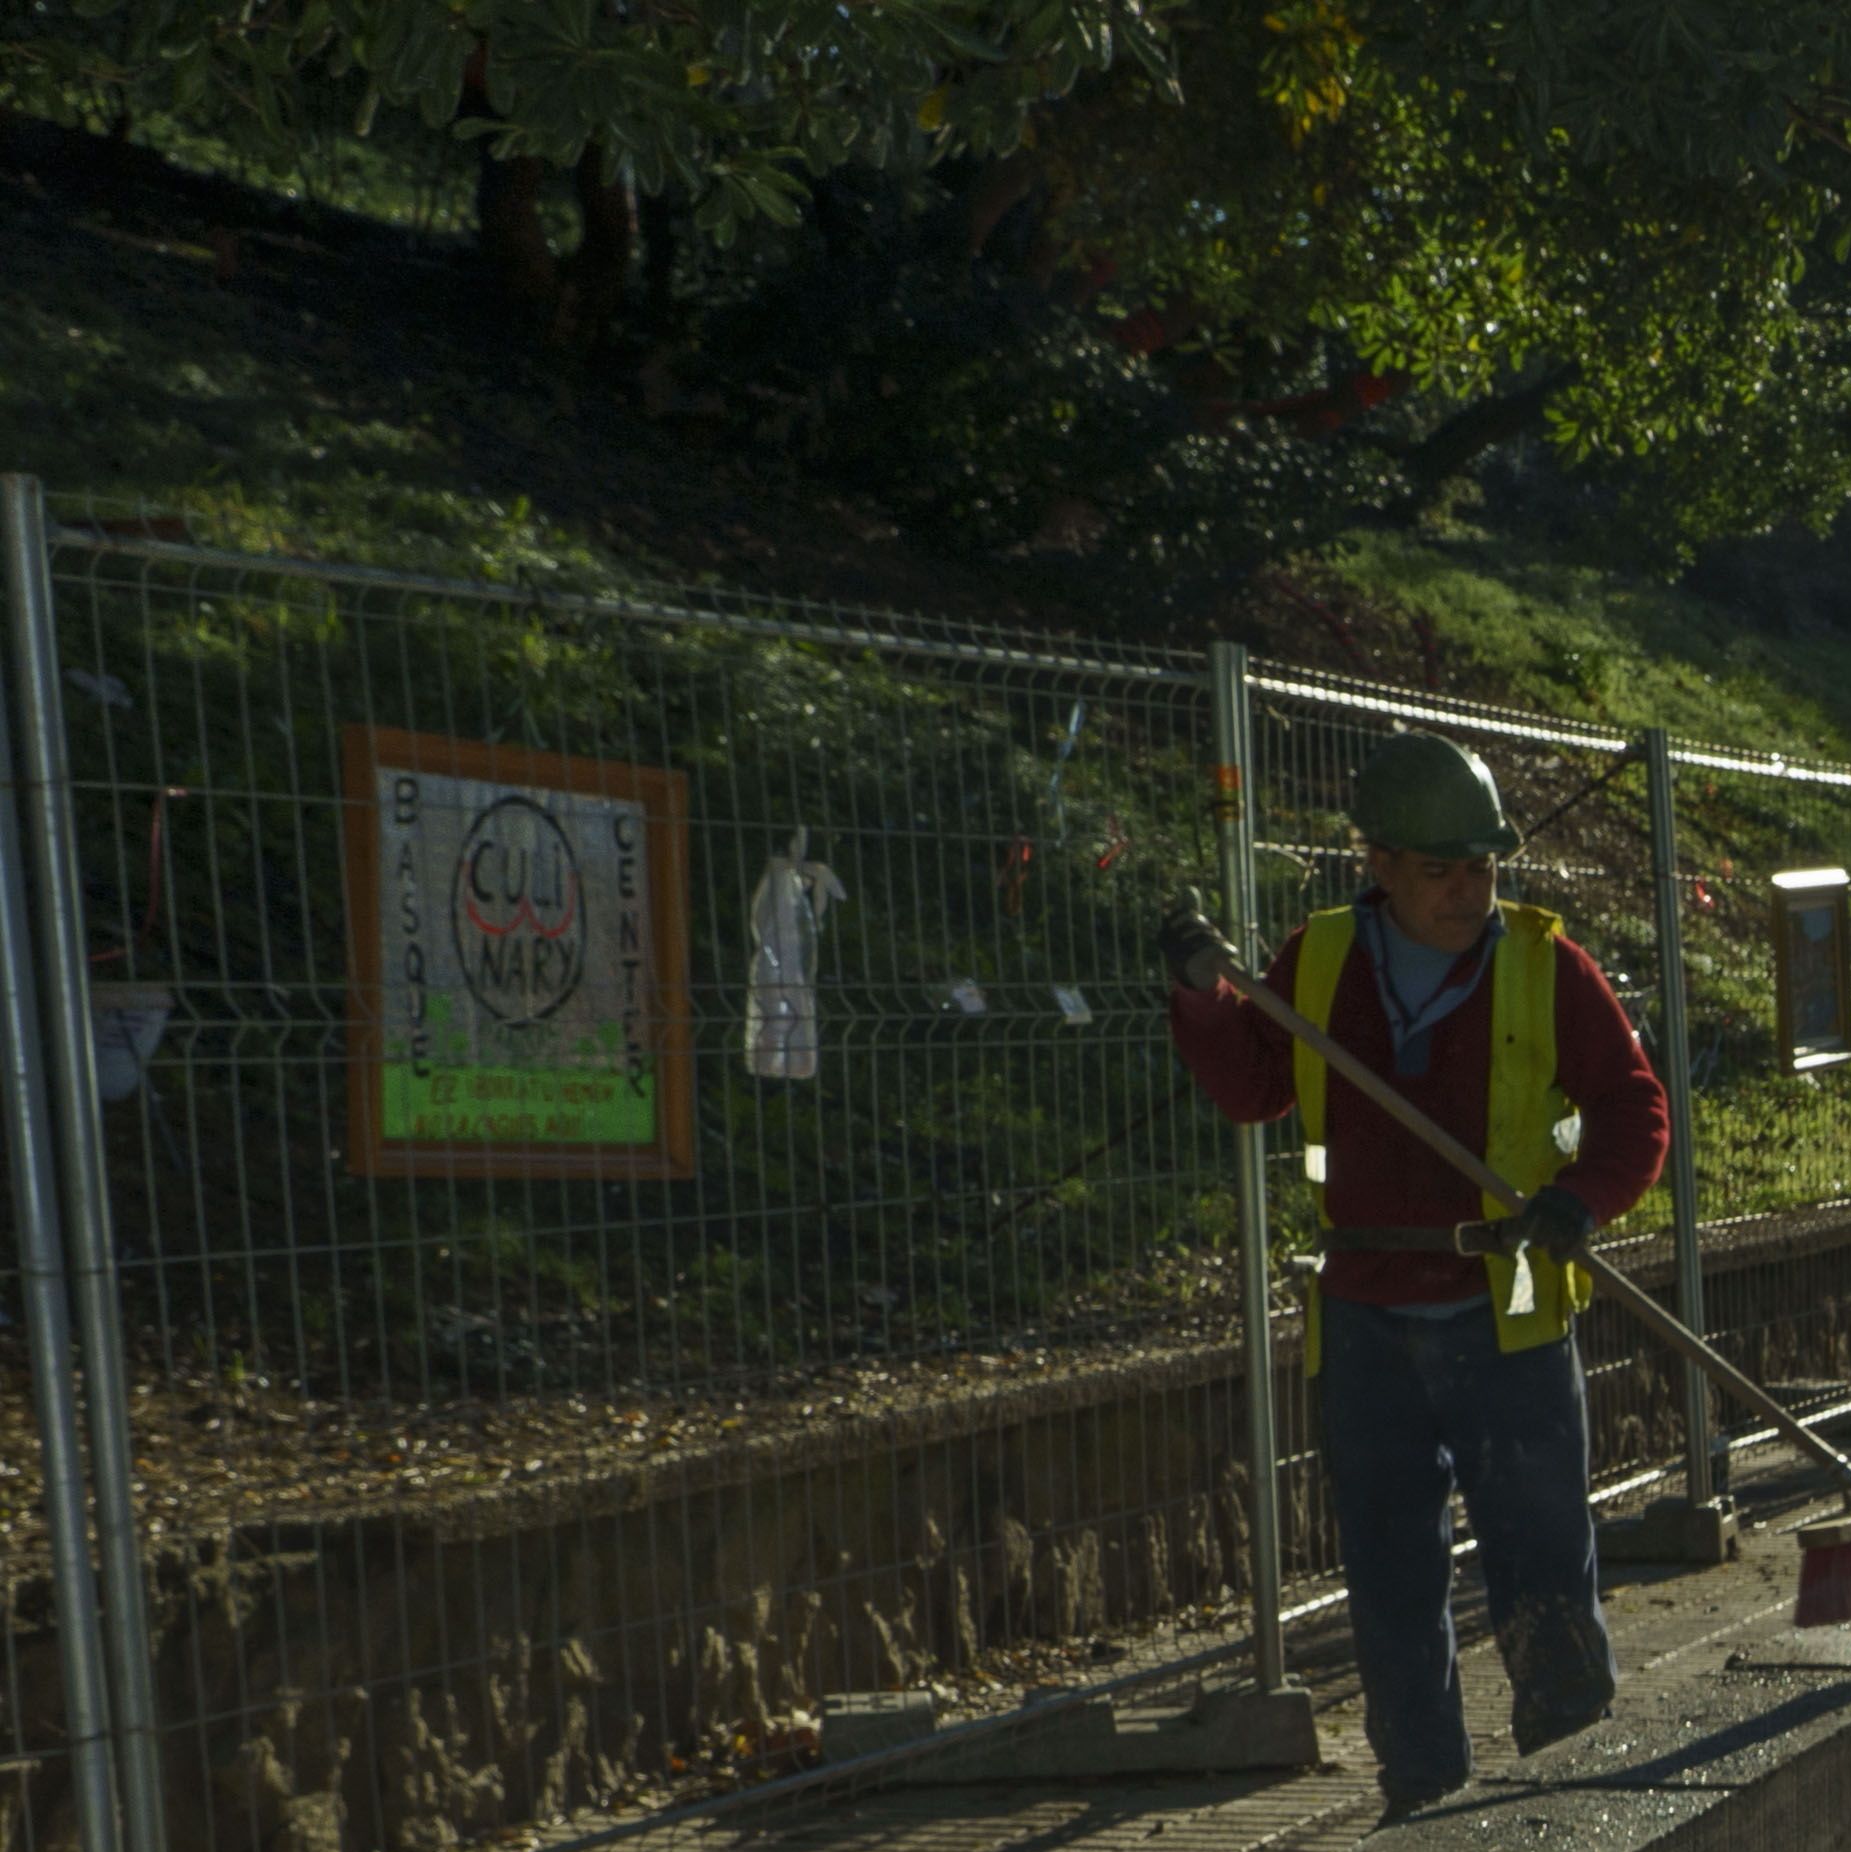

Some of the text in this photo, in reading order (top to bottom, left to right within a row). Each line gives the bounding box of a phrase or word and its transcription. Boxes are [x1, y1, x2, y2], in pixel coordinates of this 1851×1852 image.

[394, 776, 431, 1079] BASQUE
[479, 936, 576, 996] NARY
[613, 814, 646, 1098] CENTER
